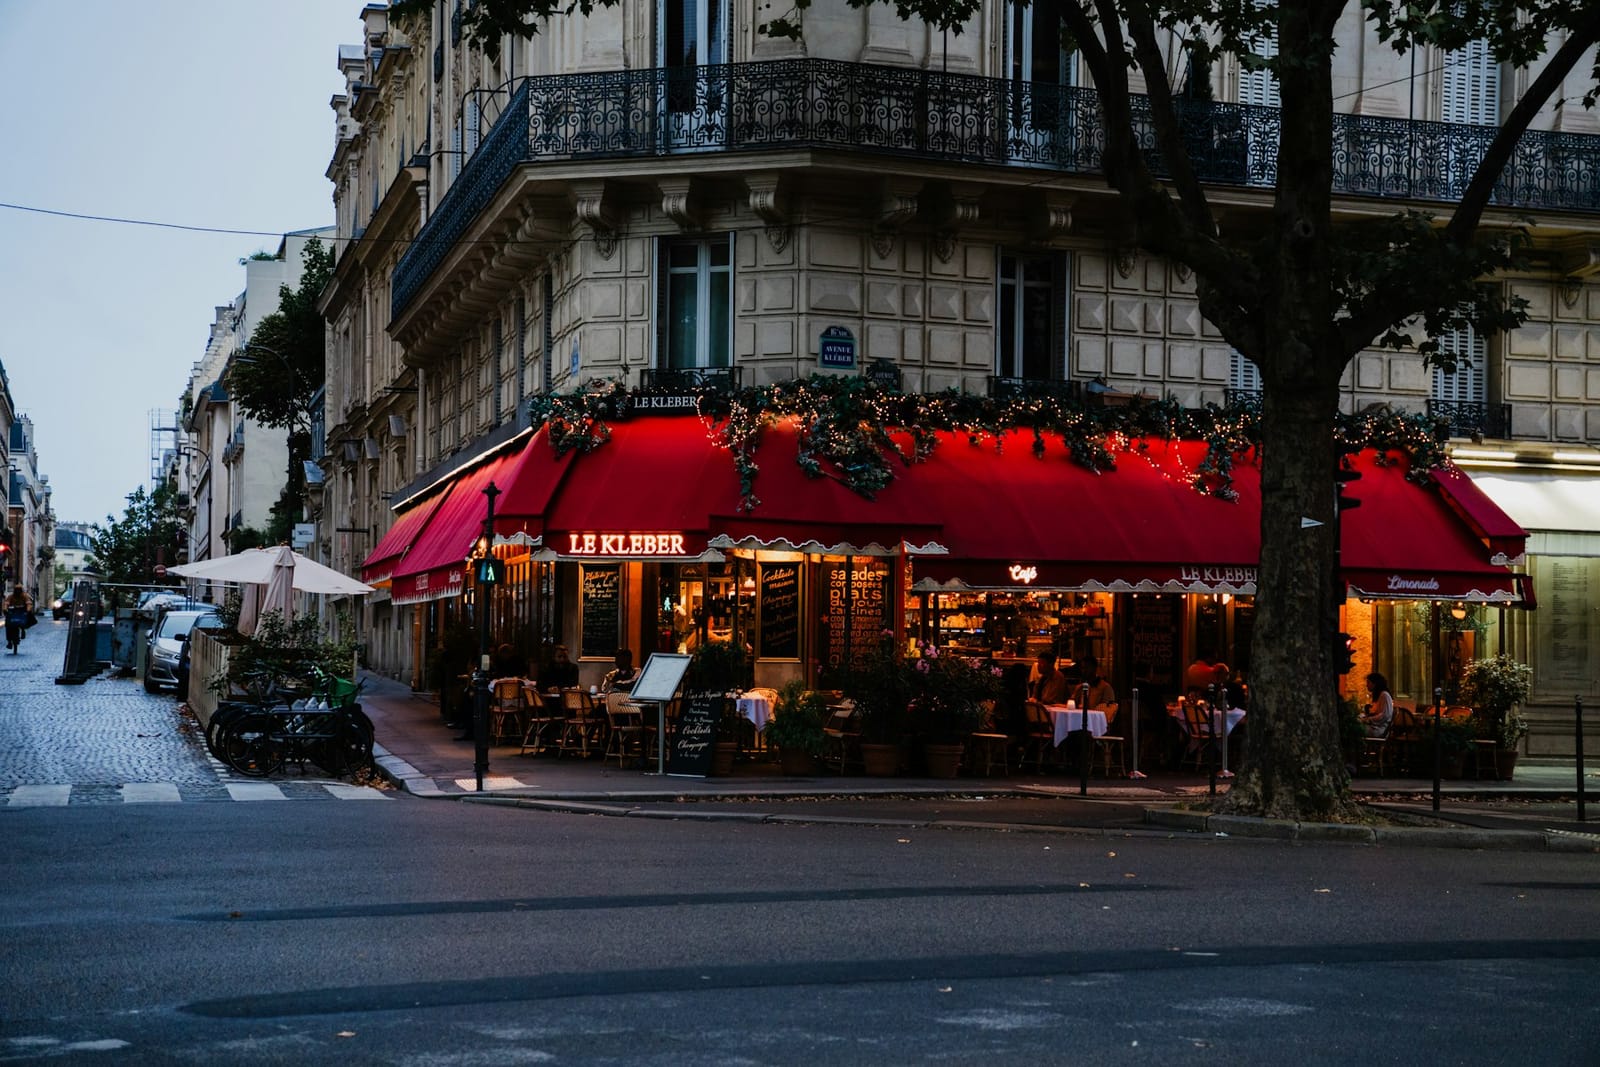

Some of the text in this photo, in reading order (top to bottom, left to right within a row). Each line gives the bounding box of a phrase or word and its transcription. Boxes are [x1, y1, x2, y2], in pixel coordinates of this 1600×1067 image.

[825, 345, 852, 354] AVENUE
[634, 396, 698, 408] LE KLEBER
[569, 534, 686, 554] LE KLEBER
[830, 566, 882, 580] saades
[1008, 564, 1038, 584] Café
[1180, 567, 1201, 580] LE
[1387, 574, 1440, 590] Limonade
[830, 587, 882, 600] plats
